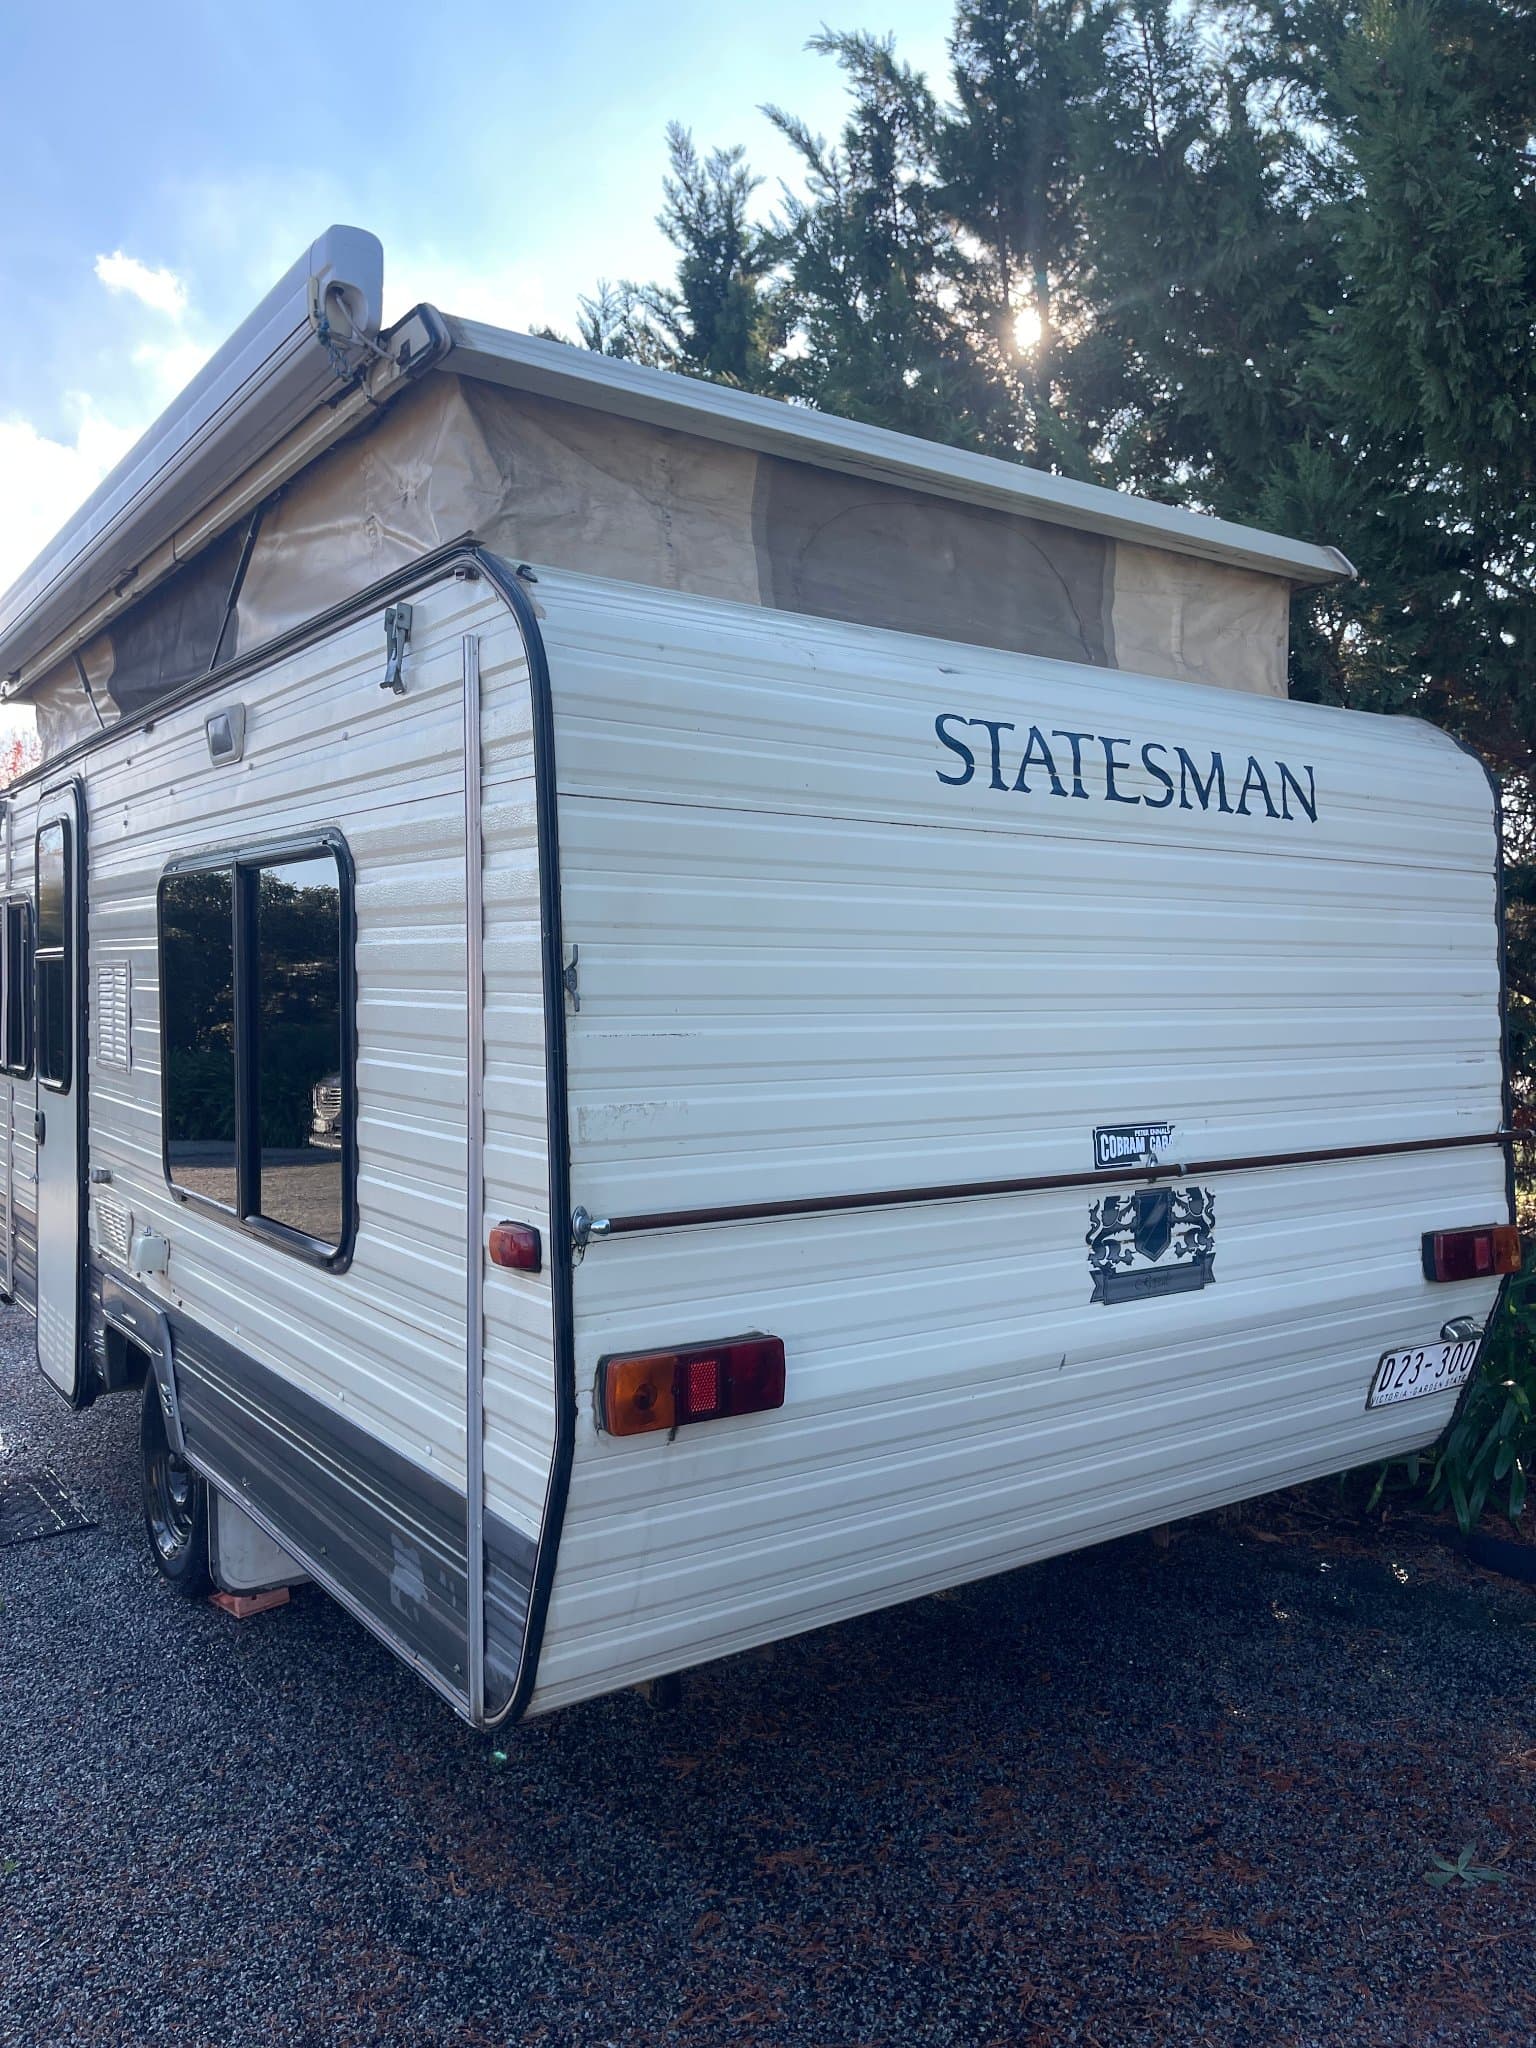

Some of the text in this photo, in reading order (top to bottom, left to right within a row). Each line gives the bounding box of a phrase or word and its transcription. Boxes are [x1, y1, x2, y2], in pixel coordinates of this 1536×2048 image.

[935, 713, 1318, 823] STATESMAN
[1101, 1133, 1145, 1162] COBRAM
[1378, 1341, 1476, 1393] D23-300
